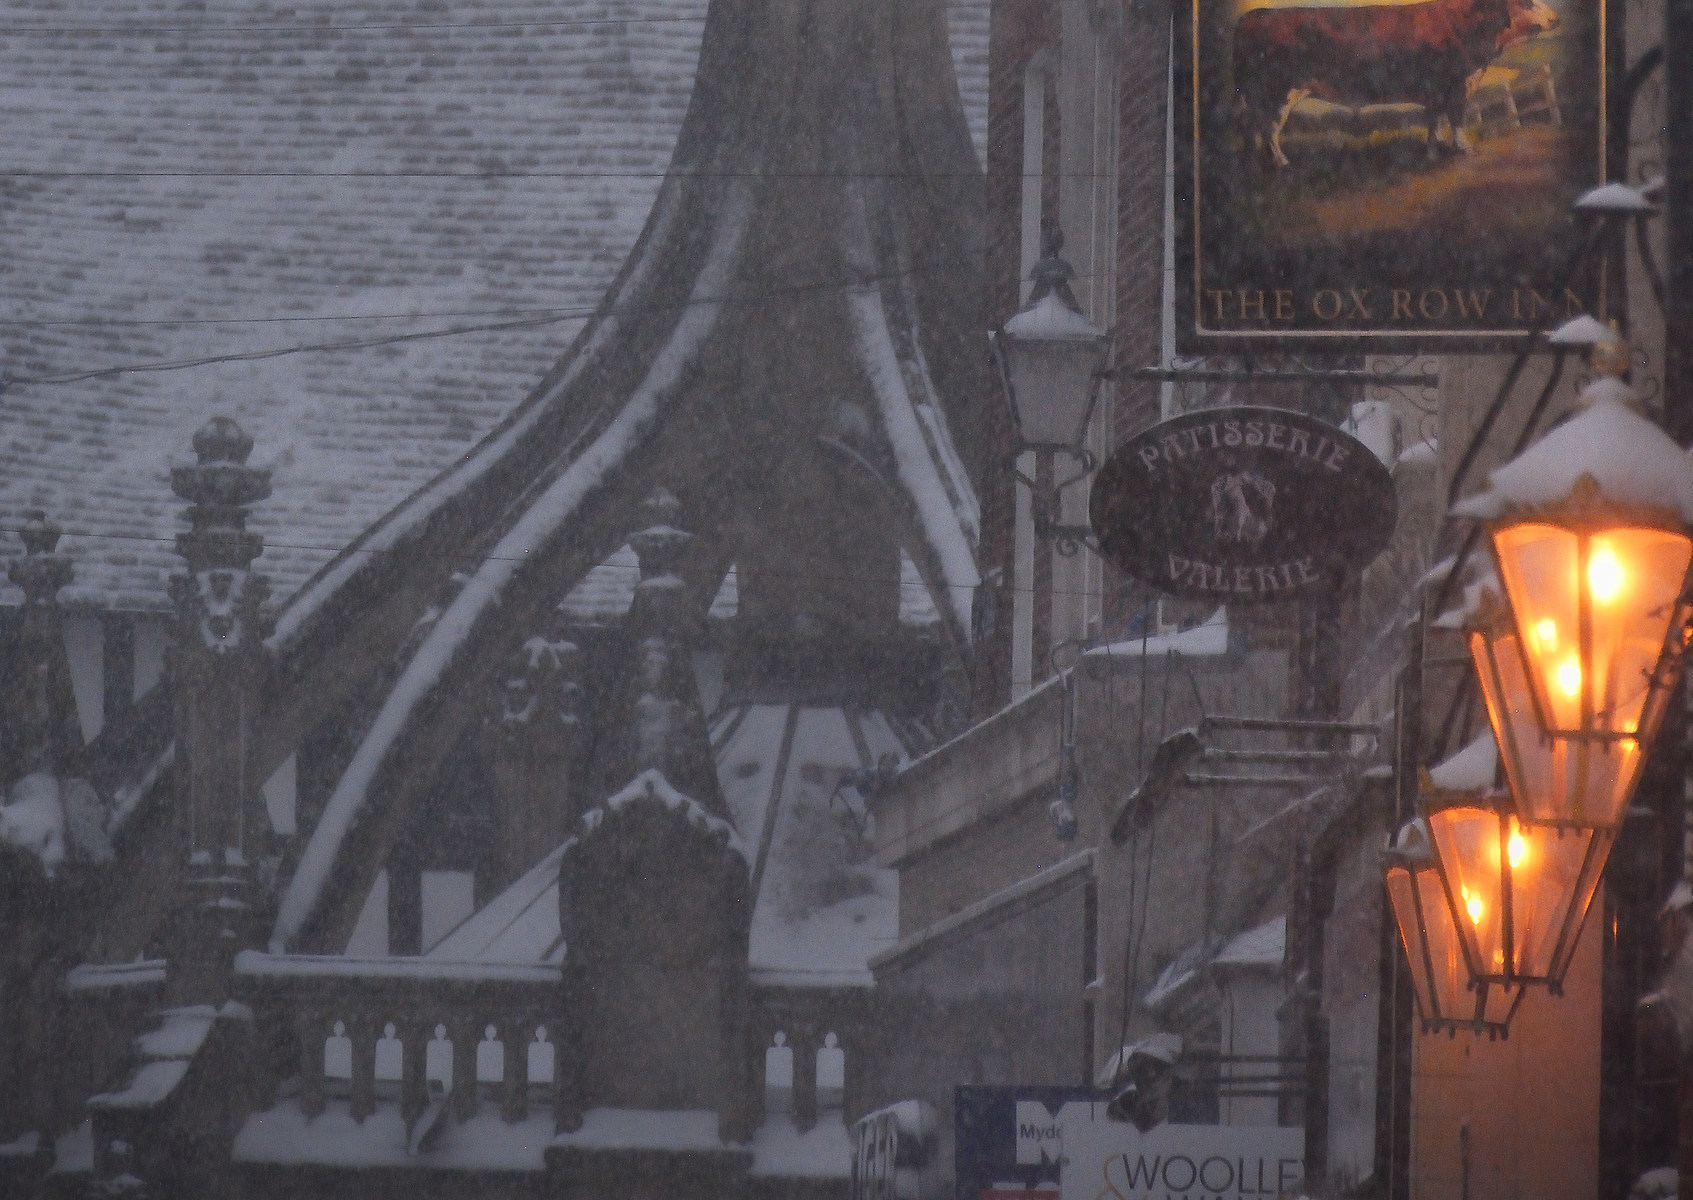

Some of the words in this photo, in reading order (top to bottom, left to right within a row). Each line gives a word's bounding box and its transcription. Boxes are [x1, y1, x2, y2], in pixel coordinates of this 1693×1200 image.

[1206, 287, 1295, 320] THE
[1311, 288, 1375, 320] OX
[1391, 287, 1494, 320] ROW
[1138, 420, 1349, 472] PATISSERIE
[1167, 553, 1319, 593] VALERIE
[1122, 1154, 1304, 1194] WOOLLE
